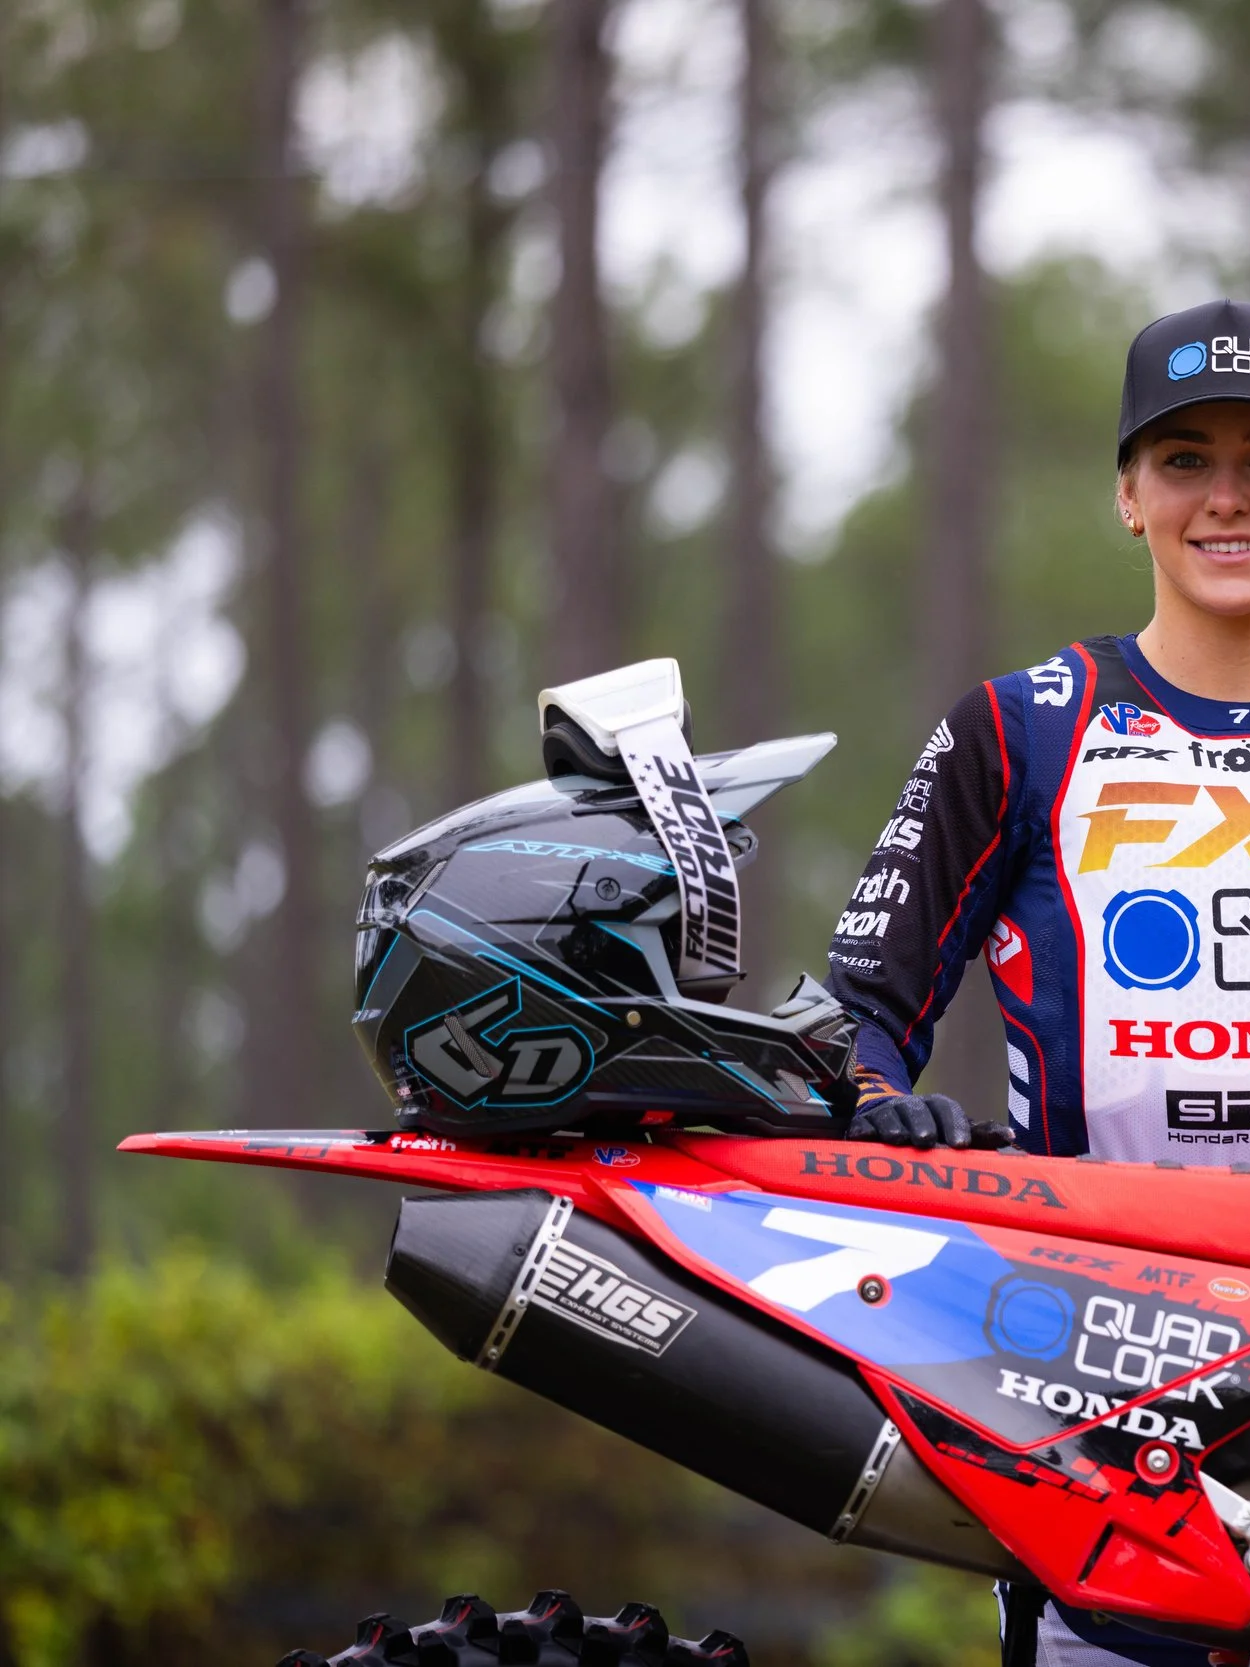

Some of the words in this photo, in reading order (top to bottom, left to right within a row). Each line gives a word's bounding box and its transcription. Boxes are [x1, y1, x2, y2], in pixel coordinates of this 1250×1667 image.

[1099, 702, 1142, 735] VP
[1228, 709, 1250, 724] 7
[1082, 746, 1180, 764] RFX
[654, 810, 704, 961] FACTORY
[390, 1135, 457, 1154] froth
[594, 1147, 628, 1166] VP
[800, 1150, 1067, 1209] HONDA
[748, 1207, 950, 1312] 7
[1028, 1246, 1125, 1272] RFX
[1137, 1264, 1196, 1289] MTF
[567, 1267, 683, 1338] HGS
[1084, 1295, 1240, 1369] QUAD
[997, 1369, 1206, 1451] HONDA
